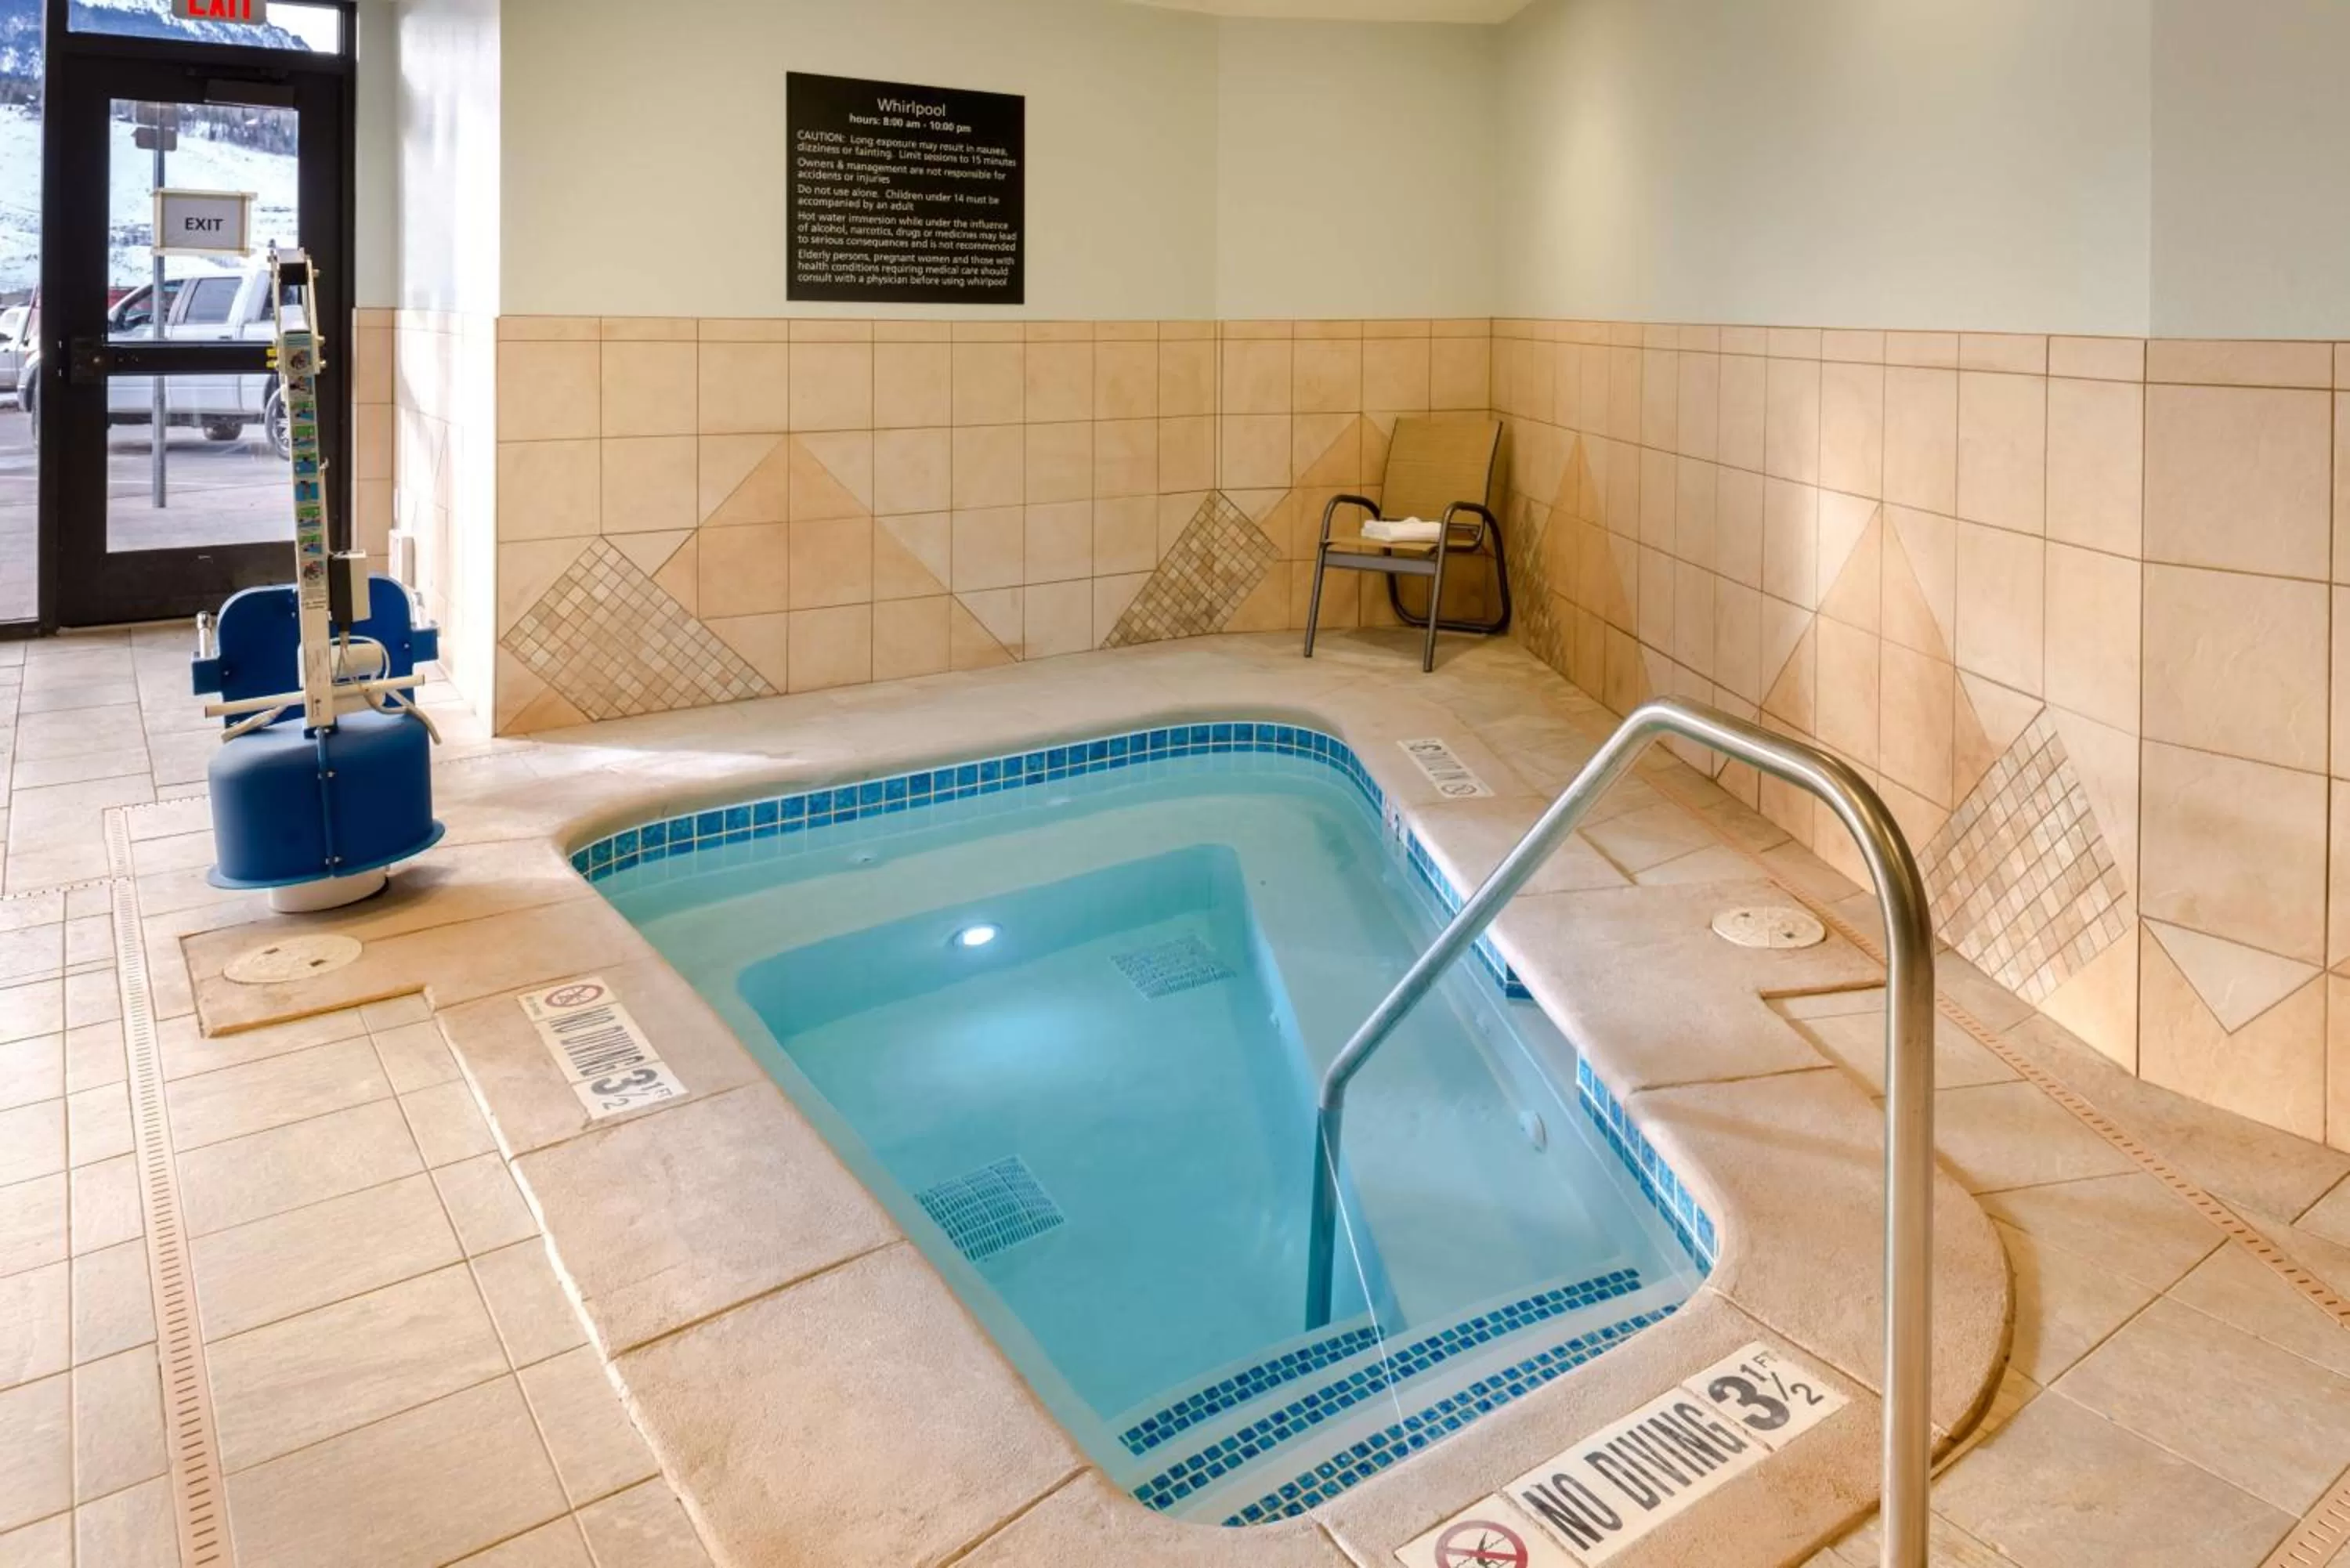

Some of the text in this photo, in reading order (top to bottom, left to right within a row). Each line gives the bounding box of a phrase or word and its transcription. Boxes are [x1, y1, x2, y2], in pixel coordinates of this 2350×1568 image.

[877, 97, 946, 117] Whirlpool
[849, 113, 881, 125] hours:
[883, 117, 903, 127] 8:00
[929, 120, 954, 132] 10:00
[956, 125, 971, 134] pm
[850, 135, 874, 146] Long
[876, 138, 916, 149] exposure
[919, 140, 938, 152] may
[940, 143, 964, 153] result
[967, 144, 974, 153] in
[797, 143, 840, 154] dizziness
[898, 150, 921, 161] Limit
[924, 152, 957, 163] sessions
[960, 154, 969, 164] to
[972, 155, 982, 164] 15
[983, 157, 1016, 167] minutes
[797, 157, 834, 169] Owners
[837, 160, 844, 170] &
[847, 162, 907, 174] management
[926, 167, 942, 176] not
[944, 169, 992, 180] responsible
[994, 170, 1007, 181] for
[797, 169, 842, 182] accidents
[856, 174, 891, 185] injuries
[797, 183, 812, 195] Do
[814, 186, 830, 196] not
[885, 189, 924, 201] Children
[925, 192, 952, 201] under
[954, 193, 964, 202] 14
[966, 194, 987, 204] must
[988, 194, 1000, 204] be
[797, 197, 861, 209] accompanied
[862, 199, 874, 211] by
[889, 201, 914, 211] adult
[185, 217, 224, 231] EXIT
[797, 211, 1009, 230] Hot water immersion while under the influence
[797, 222, 808, 233] of
[895, 227, 921, 239] drugs
[935, 228, 978, 239] medicines
[979, 233, 997, 241] may
[999, 231, 1017, 240] lead
[797, 235, 1016, 251] to serious consequences and is not recommended
[798, 249, 830, 262] Elderly
[873, 253, 915, 264] pregnant
[952, 255, 969, 264] and
[971, 255, 994, 265] those
[996, 257, 1015, 266] with
[797, 261, 830, 271] health
[831, 262, 879, 273] conditions
[881, 264, 924, 276] requiring
[924, 265, 960, 275] medical
[980, 266, 1009, 276] should
[797, 273, 833, 283] consult
[834, 273, 856, 284] with
[866, 274, 908, 287] physician
[909, 275, 940, 285] before
[942, 277, 965, 287] using
[967, 276, 1008, 288] whirlpool
[548, 1006, 646, 1078] NO DIVING
[1521, 1403, 1749, 1551] NO DIVING
